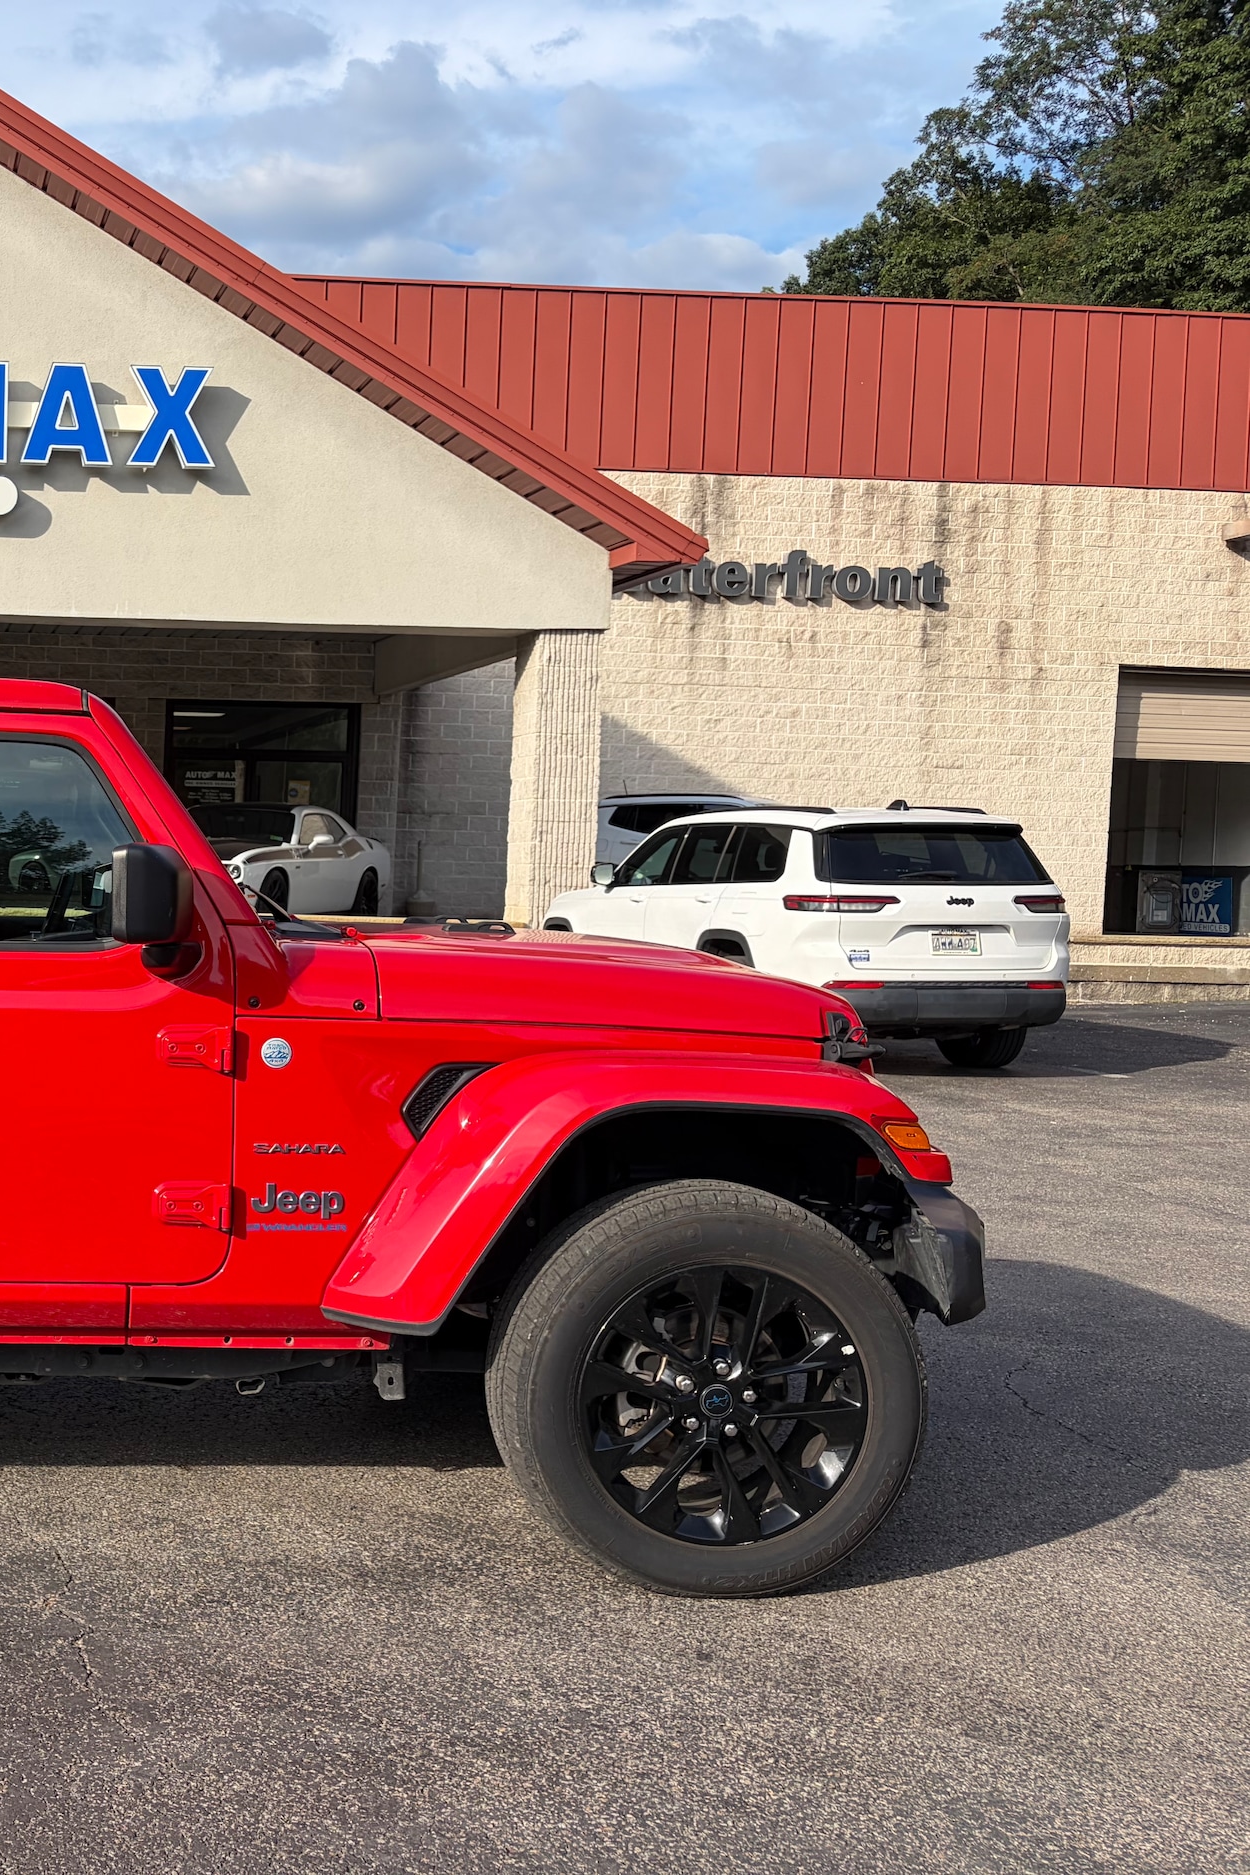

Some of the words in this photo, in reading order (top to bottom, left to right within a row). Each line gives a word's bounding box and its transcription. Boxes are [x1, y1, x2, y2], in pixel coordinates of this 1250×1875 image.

[622, 550, 944, 603] aterfront
[185, 771, 208, 779] AUTO
[217, 771, 237, 779] MAX
[946, 896, 975, 907] Jeep
[1182, 903, 1220, 923] MAX
[1194, 924, 1228, 932] VEHICLES
[253, 1143, 345, 1154] SAHARA
[251, 1182, 344, 1219] Jeep
